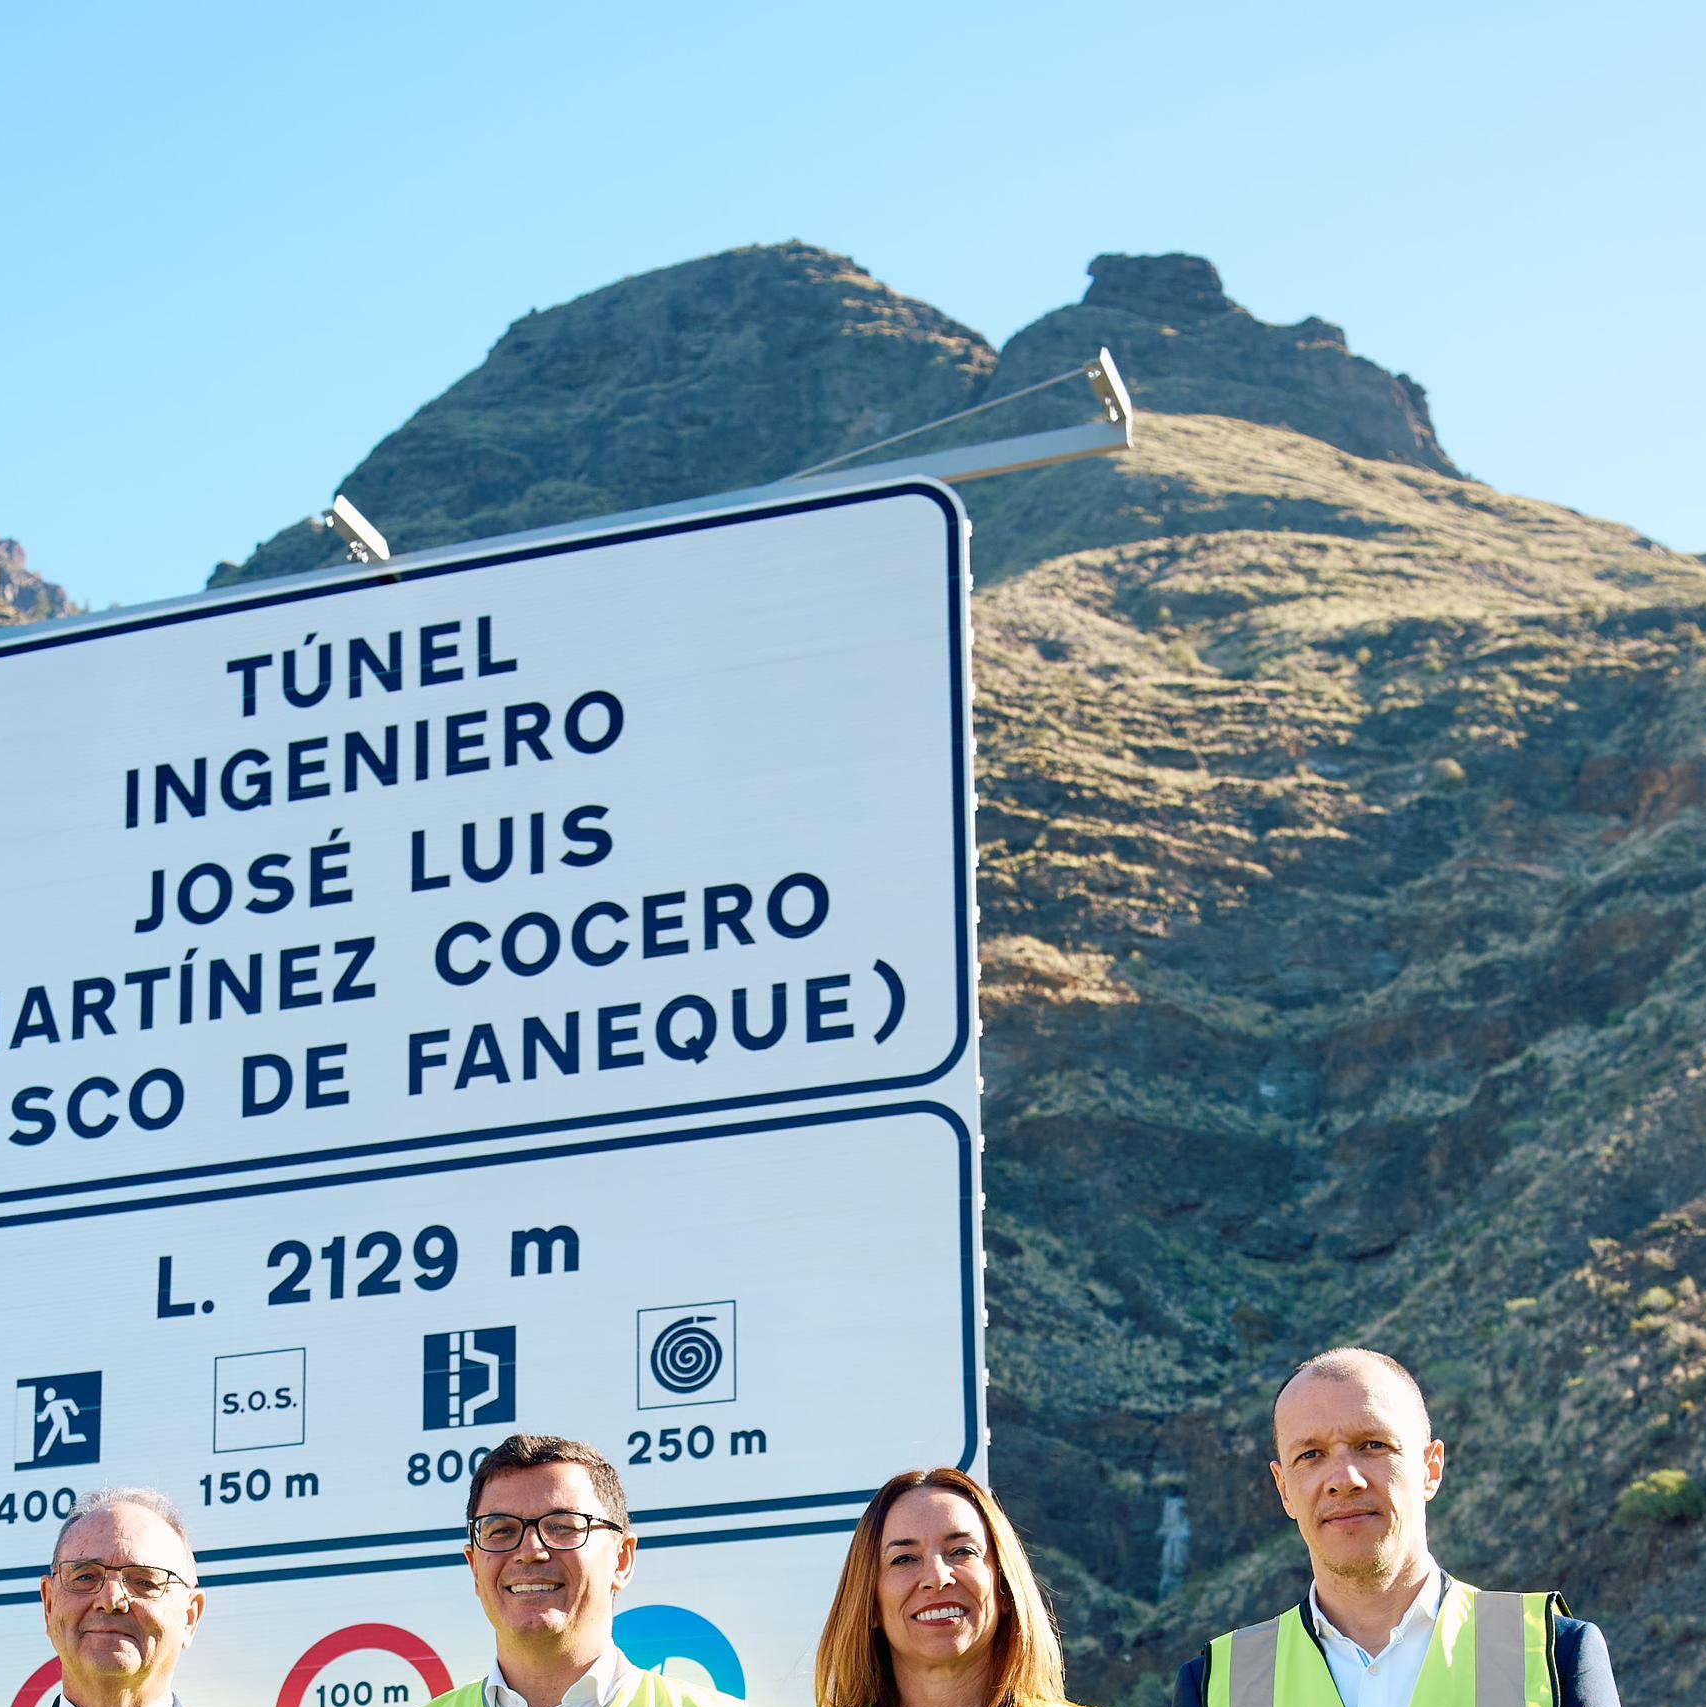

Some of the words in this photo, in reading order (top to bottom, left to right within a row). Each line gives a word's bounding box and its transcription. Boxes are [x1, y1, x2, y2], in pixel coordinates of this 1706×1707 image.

[225, 614, 519, 719] TÚNEL
[123, 689, 626, 831] INGENIERO
[133, 826, 354, 936] JOSÉ
[409, 804, 615, 895] LUIS
[433, 871, 831, 988] COCERO
[241, 1042, 351, 1120] DE
[407, 958, 907, 1098] FANEQUE)
[156, 1255, 215, 1320] L.
[266, 1224, 460, 1307] 2129
[510, 1224, 580, 1278] m
[221, 1387, 297, 1415] S.O.S.
[626, 1427, 715, 1467] 250
[730, 1428, 768, 1458] m
[199, 1468, 272, 1507] 150
[285, 1472, 319, 1499] m
[383, 1684, 409, 1704] m
